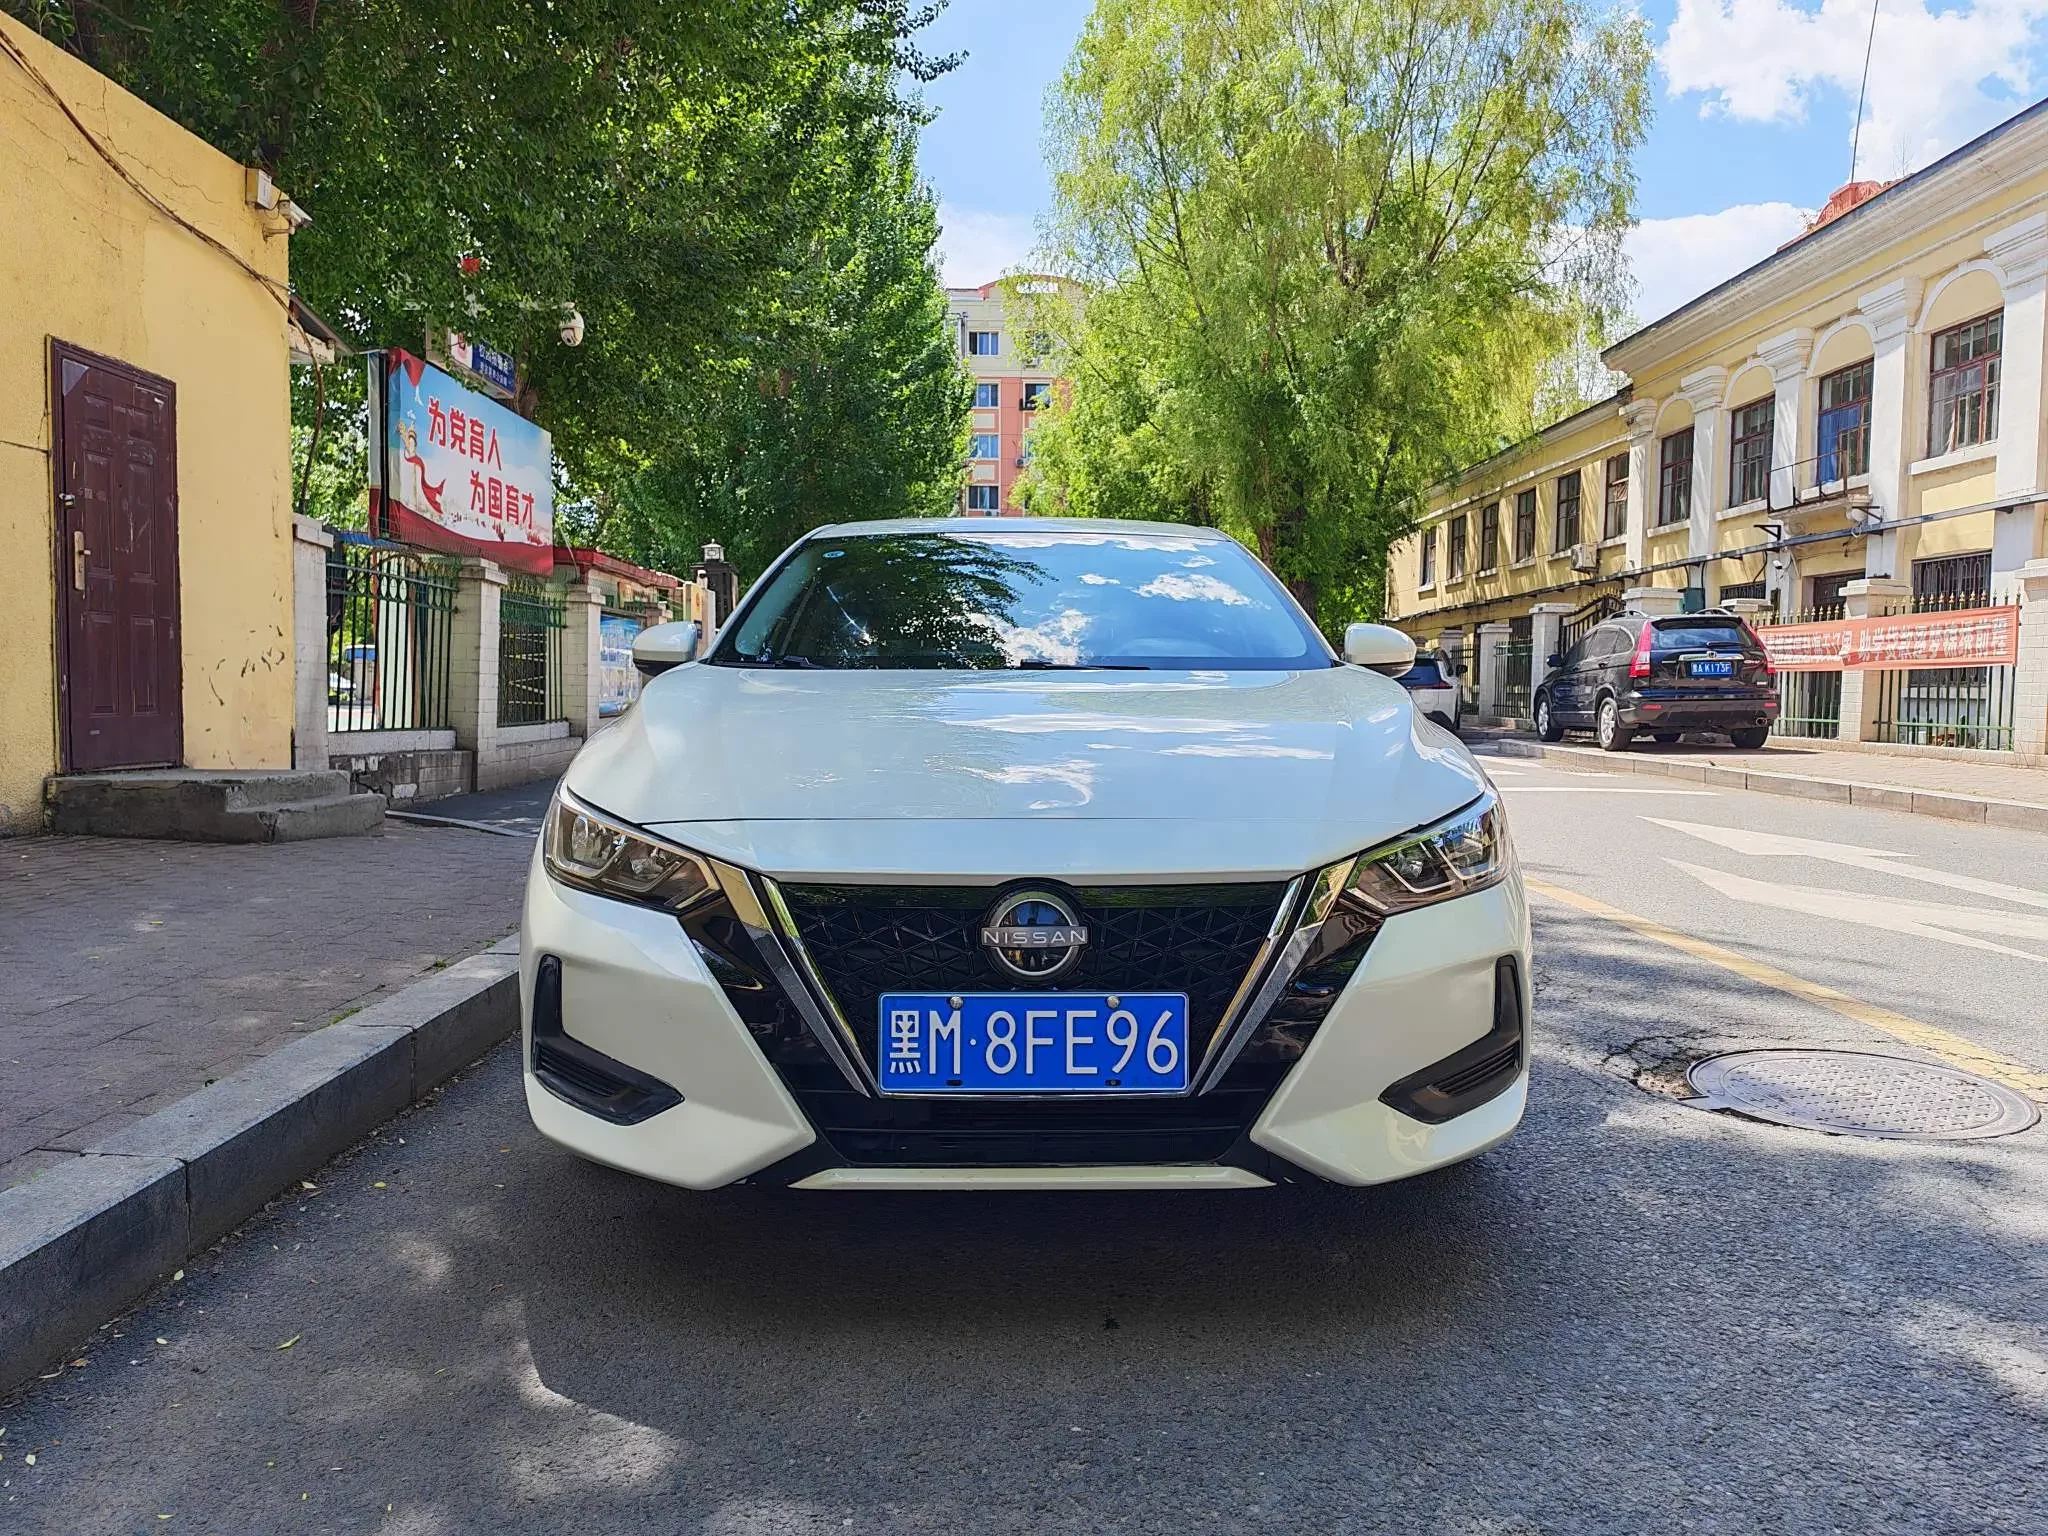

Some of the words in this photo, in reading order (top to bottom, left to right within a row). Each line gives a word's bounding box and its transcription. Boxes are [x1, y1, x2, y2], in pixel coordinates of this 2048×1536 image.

[428, 397, 502, 471] 为党育人
[469, 469, 535, 530] 为国育才
[982, 930, 1087, 944] NISSAN
